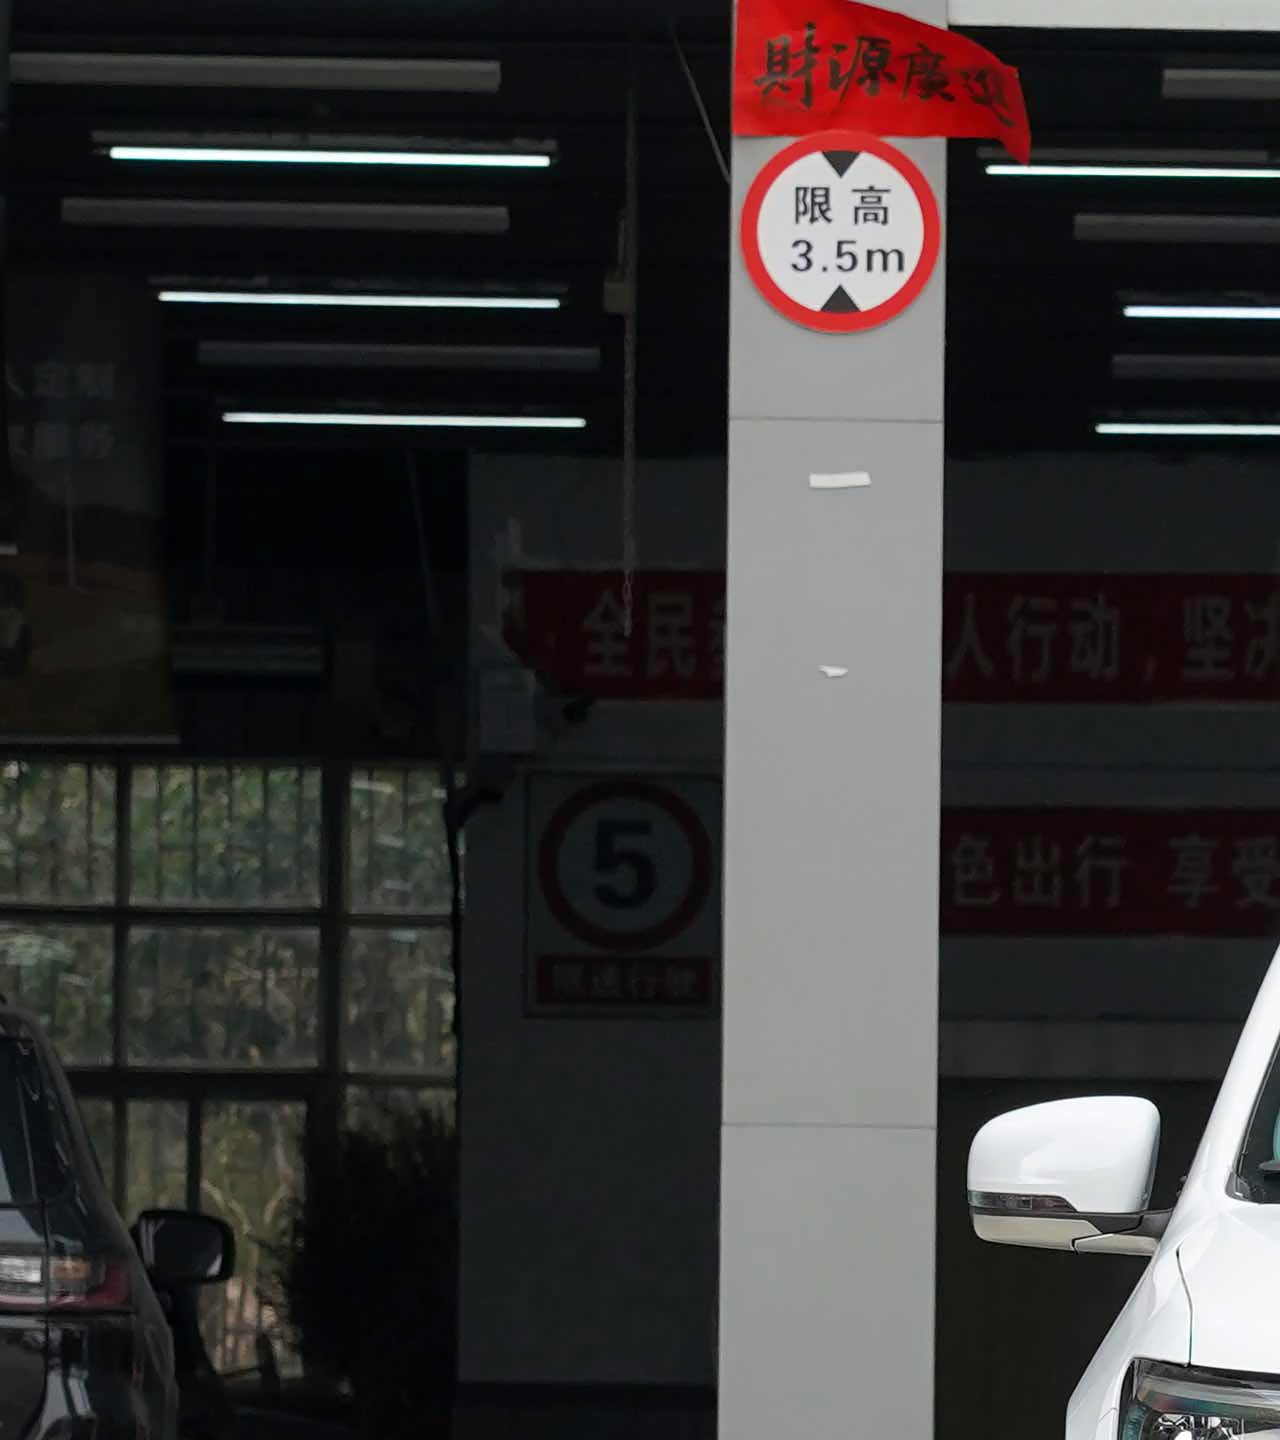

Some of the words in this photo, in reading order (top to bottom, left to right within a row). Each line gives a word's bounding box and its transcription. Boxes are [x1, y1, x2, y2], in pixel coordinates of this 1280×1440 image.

[793, 186, 892, 227] 限高
[790, 239, 905, 274] 3.5m
[594, 818, 657, 910] 5
[952, 832, 1127, 910] 色出行
